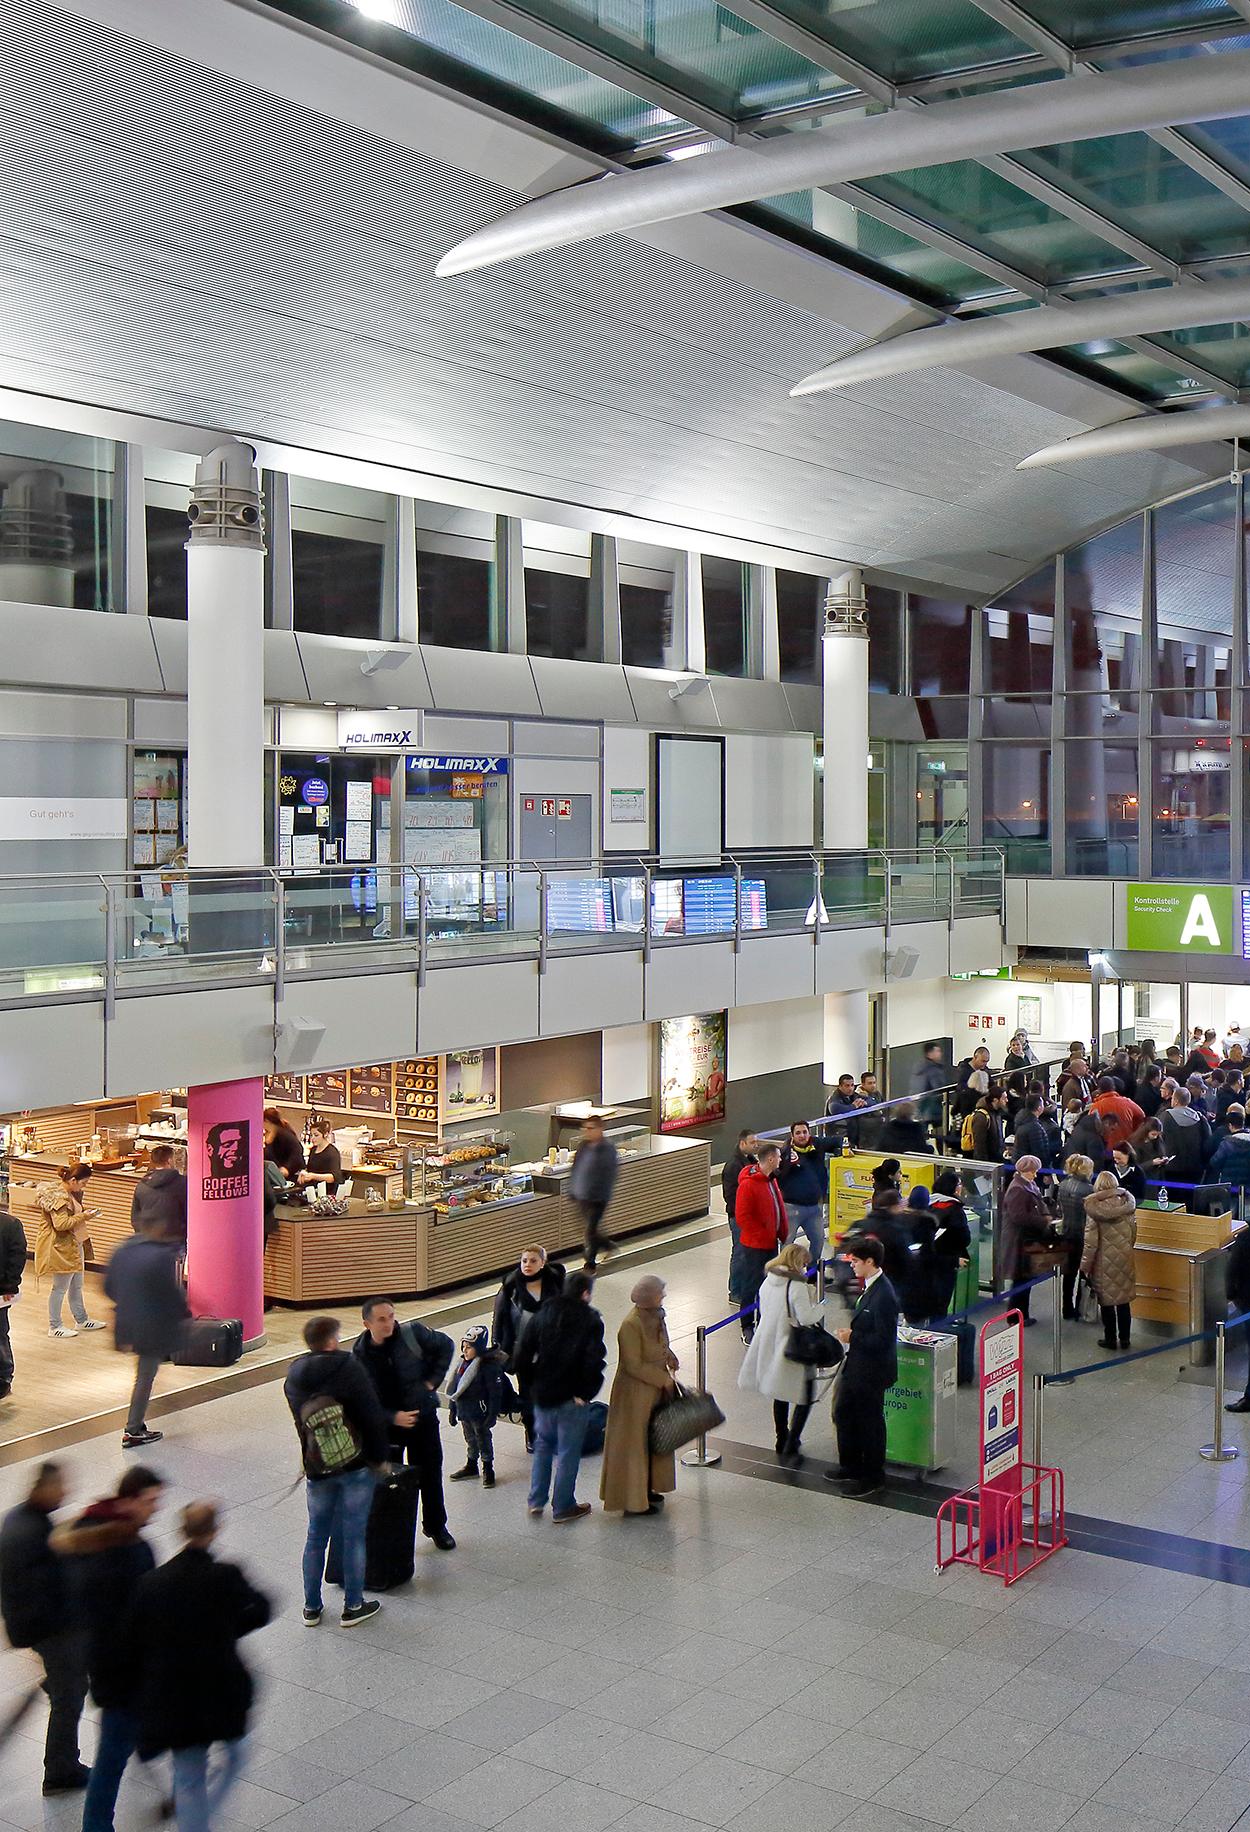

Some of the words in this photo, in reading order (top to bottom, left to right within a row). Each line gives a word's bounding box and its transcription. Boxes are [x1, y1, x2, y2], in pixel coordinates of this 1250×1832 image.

[29, 810, 46, 818] Gut
[48, 810, 75, 820] geht's
[1134, 896, 1180, 905] Kontrollstelle
[1134, 906, 1155, 914] Security
[1179, 893, 1221, 946] A
[203, 1175, 248, 1190] COFFEE
[203, 1187, 248, 1198] FELLOWS
[883, 1400, 908, 1410] uropa
